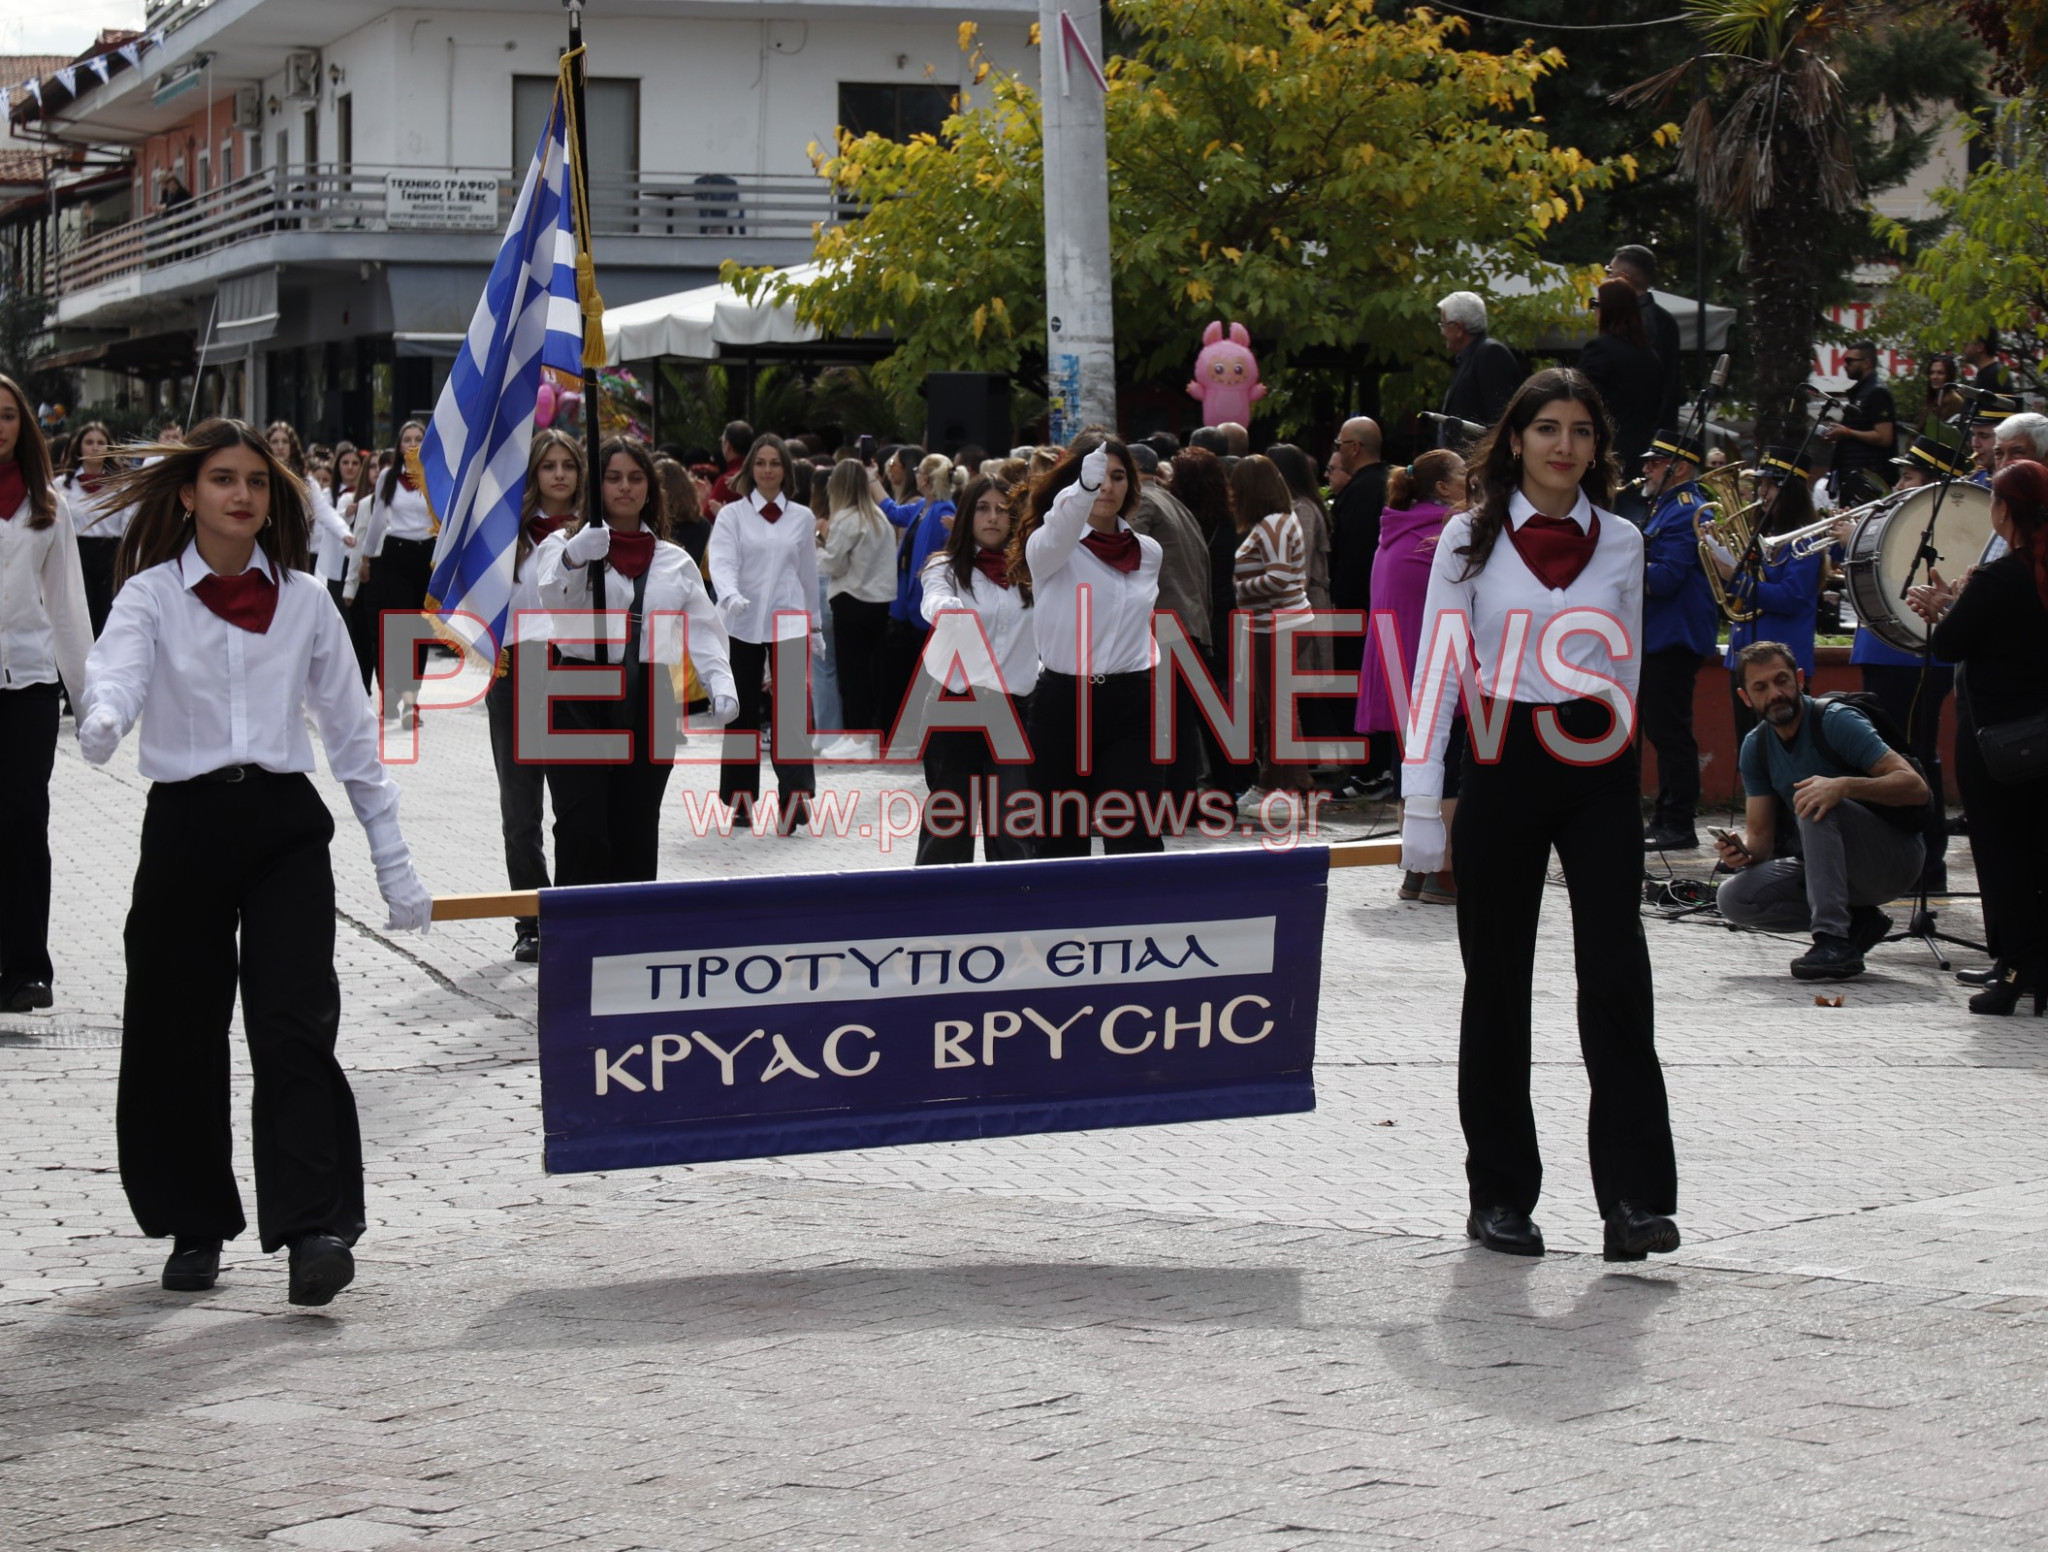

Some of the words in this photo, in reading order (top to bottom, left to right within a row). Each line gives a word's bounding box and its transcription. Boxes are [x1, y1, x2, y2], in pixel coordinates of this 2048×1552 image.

[391, 179, 441, 190] ΤΕΧΝΙΚΟ
[444, 180, 496, 191] ΓΡΑΦΕΙΟ
[645, 945, 1005, 1000] ΠΡΟΤΥΠΟ
[1046, 934, 1220, 978] ΕΠΑΛ
